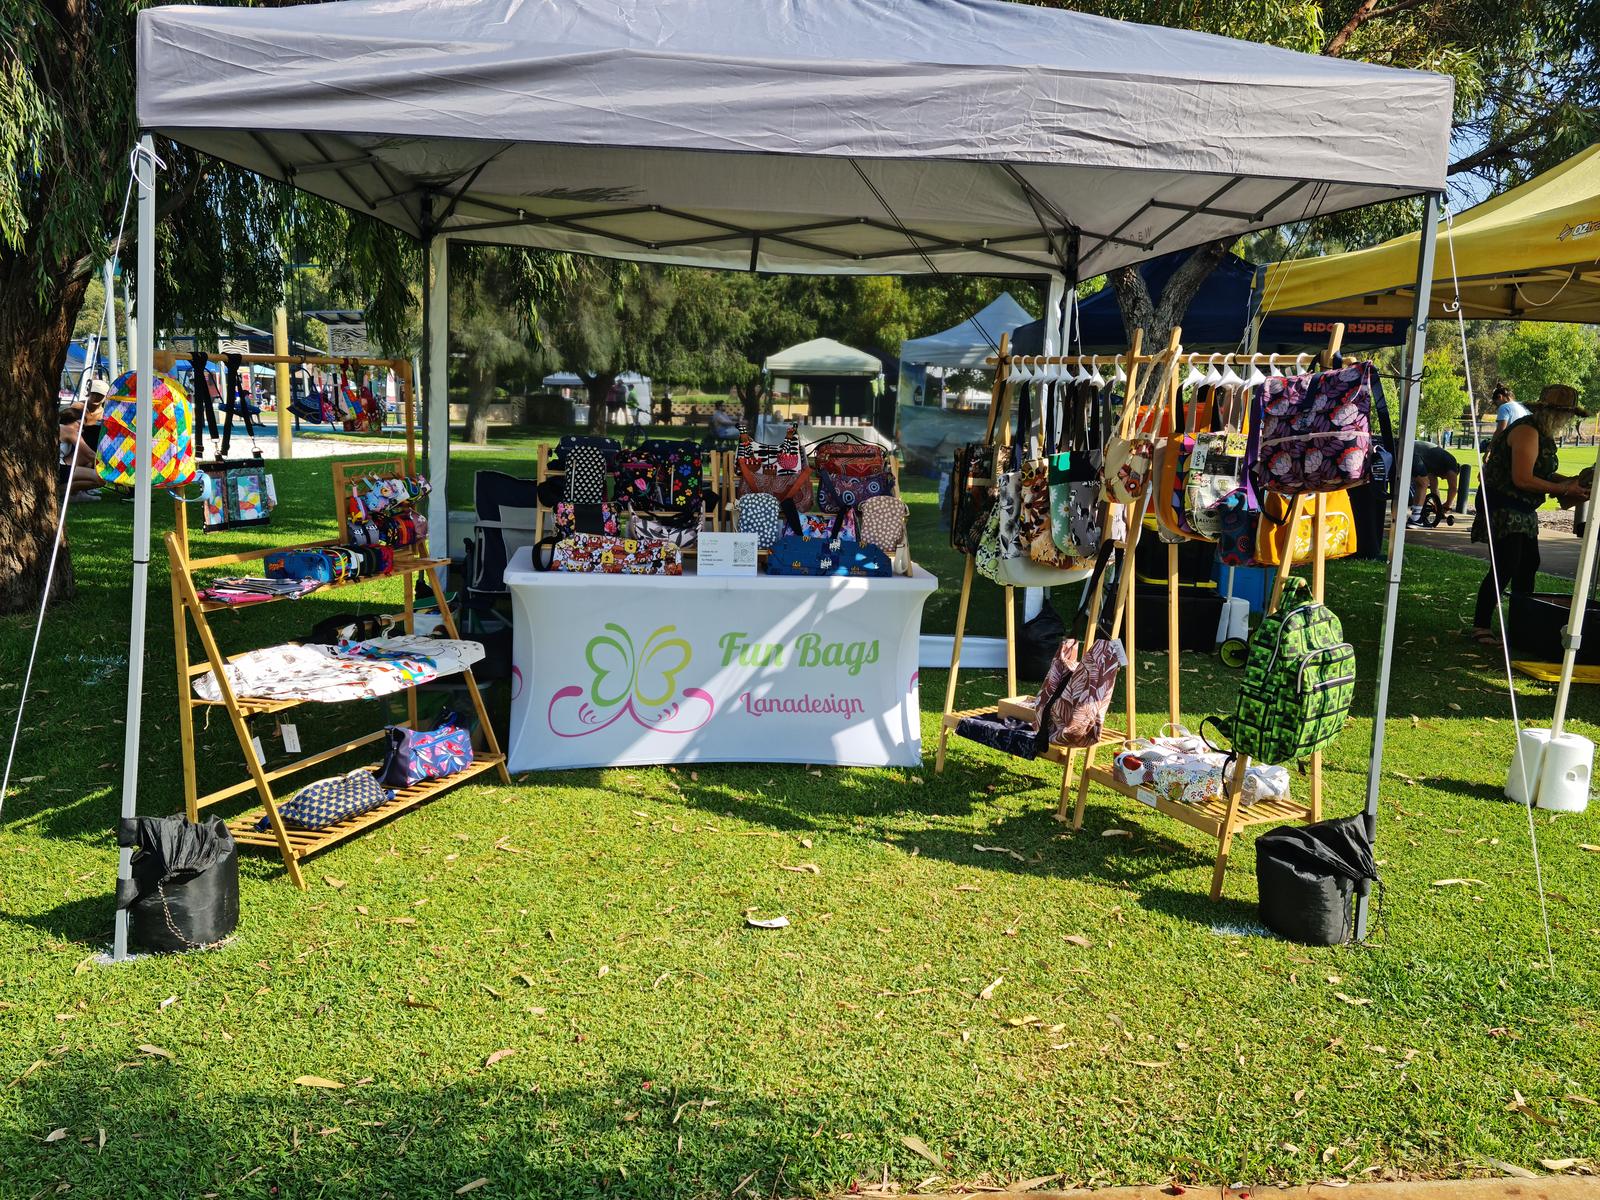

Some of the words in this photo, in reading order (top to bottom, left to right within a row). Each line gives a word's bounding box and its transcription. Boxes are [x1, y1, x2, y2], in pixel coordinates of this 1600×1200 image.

[1303, 322, 1334, 333] RIDG
[1347, 323, 1393, 333] RYDER
[719, 632, 784, 667] Fun
[795, 633, 879, 676] Bags
[739, 692, 865, 720] Lanadesign
